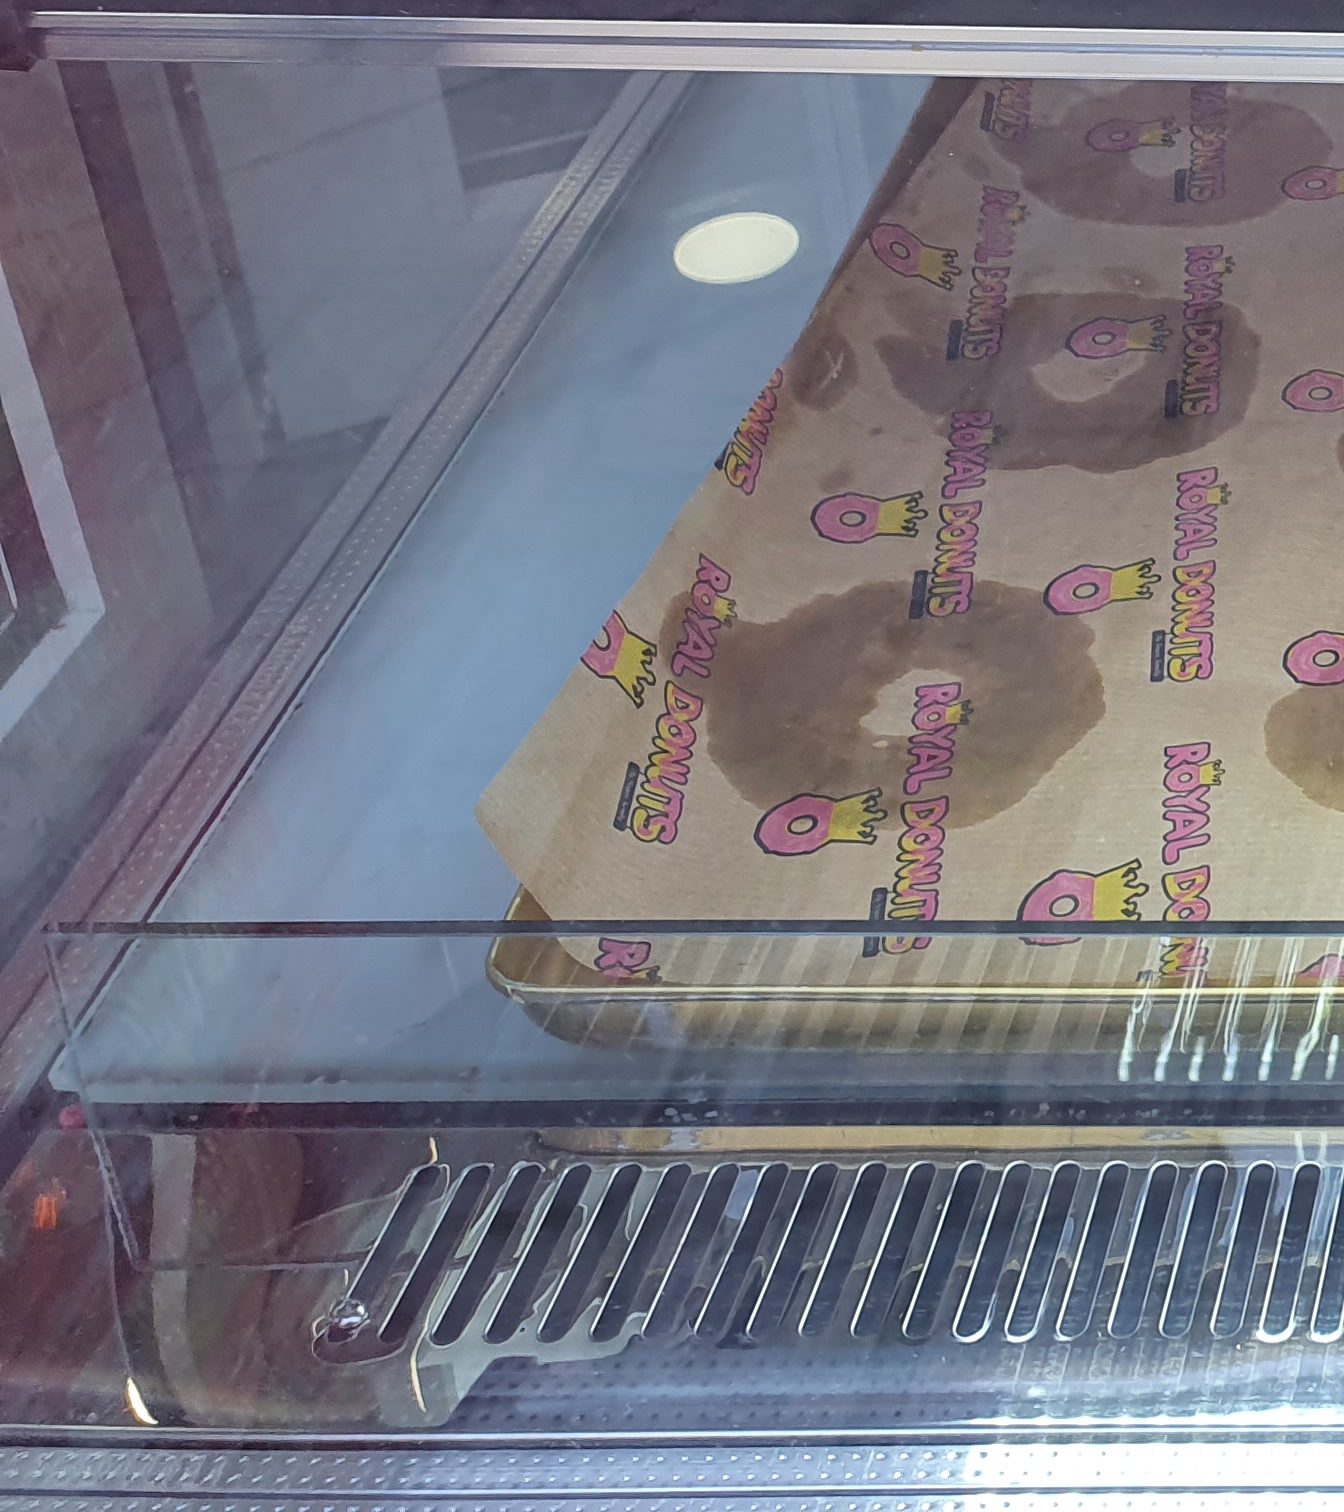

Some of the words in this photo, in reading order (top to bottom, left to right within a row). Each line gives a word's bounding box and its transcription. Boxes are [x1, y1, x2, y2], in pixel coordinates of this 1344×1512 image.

[1183, 244, 1234, 320] ROYAL
[1182, 321, 1223, 417] DONUTS
[941, 410, 999, 498] ROYAL
[928, 500, 983, 618] DONUTS
[1175, 466, 1231, 560] ROYAL
[671, 552, 736, 679] ROYAL
[1168, 559, 1215, 682] DONUTS
[630, 681, 704, 845] DONUTS
[903, 681, 974, 795] ROYAL
[1162, 741, 1225, 865] ROYAL
